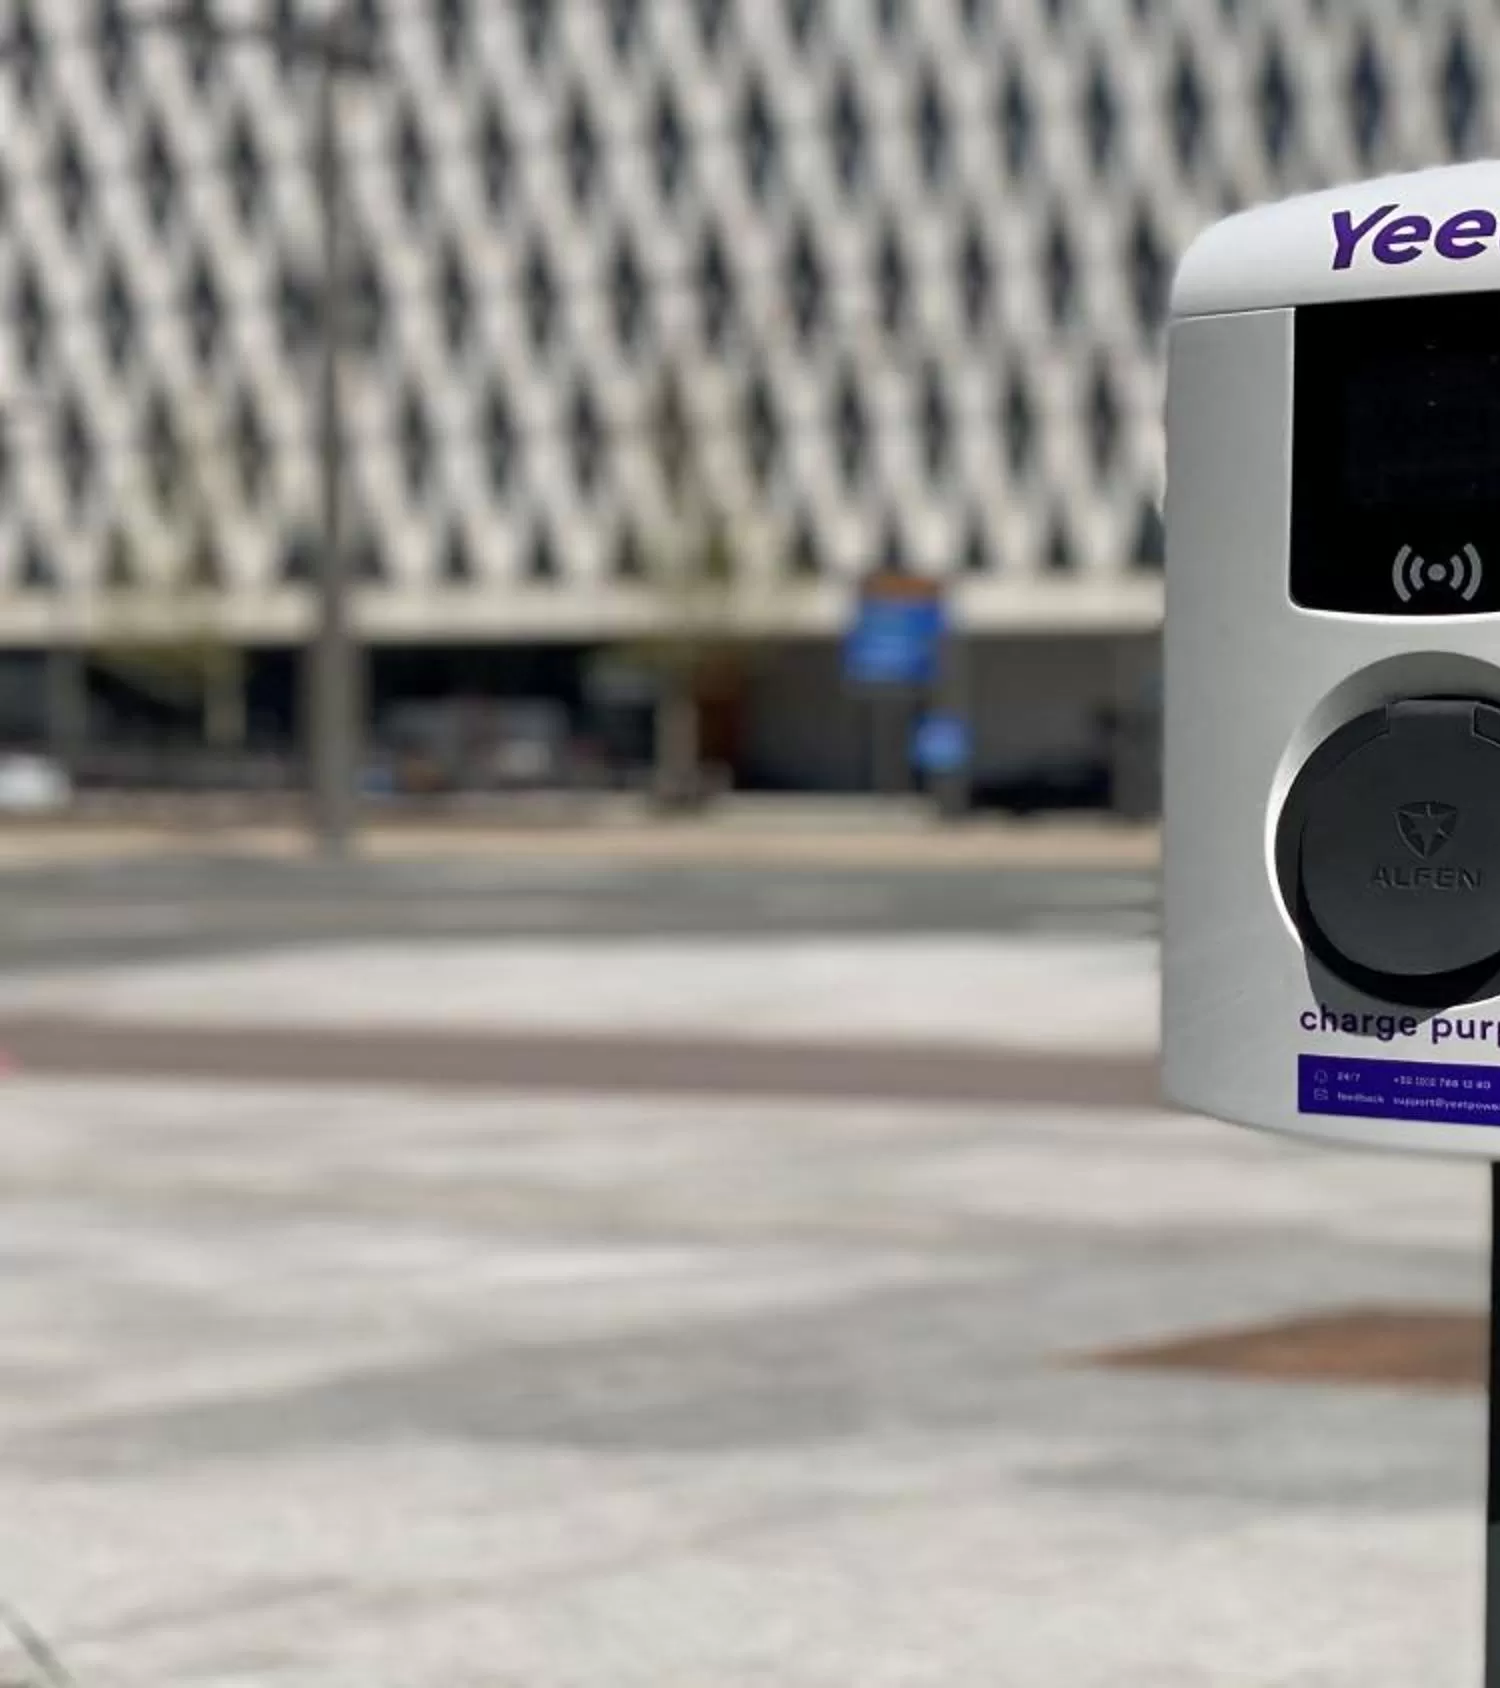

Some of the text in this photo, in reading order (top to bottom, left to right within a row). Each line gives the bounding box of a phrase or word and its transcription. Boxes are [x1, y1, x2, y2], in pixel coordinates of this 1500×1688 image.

[1369, 866, 1483, 891] ALFEN
[1300, 1003, 1417, 1042] charge
[1337, 1071, 1361, 1083] 24/7
[1337, 1091, 1385, 1105] feedback
